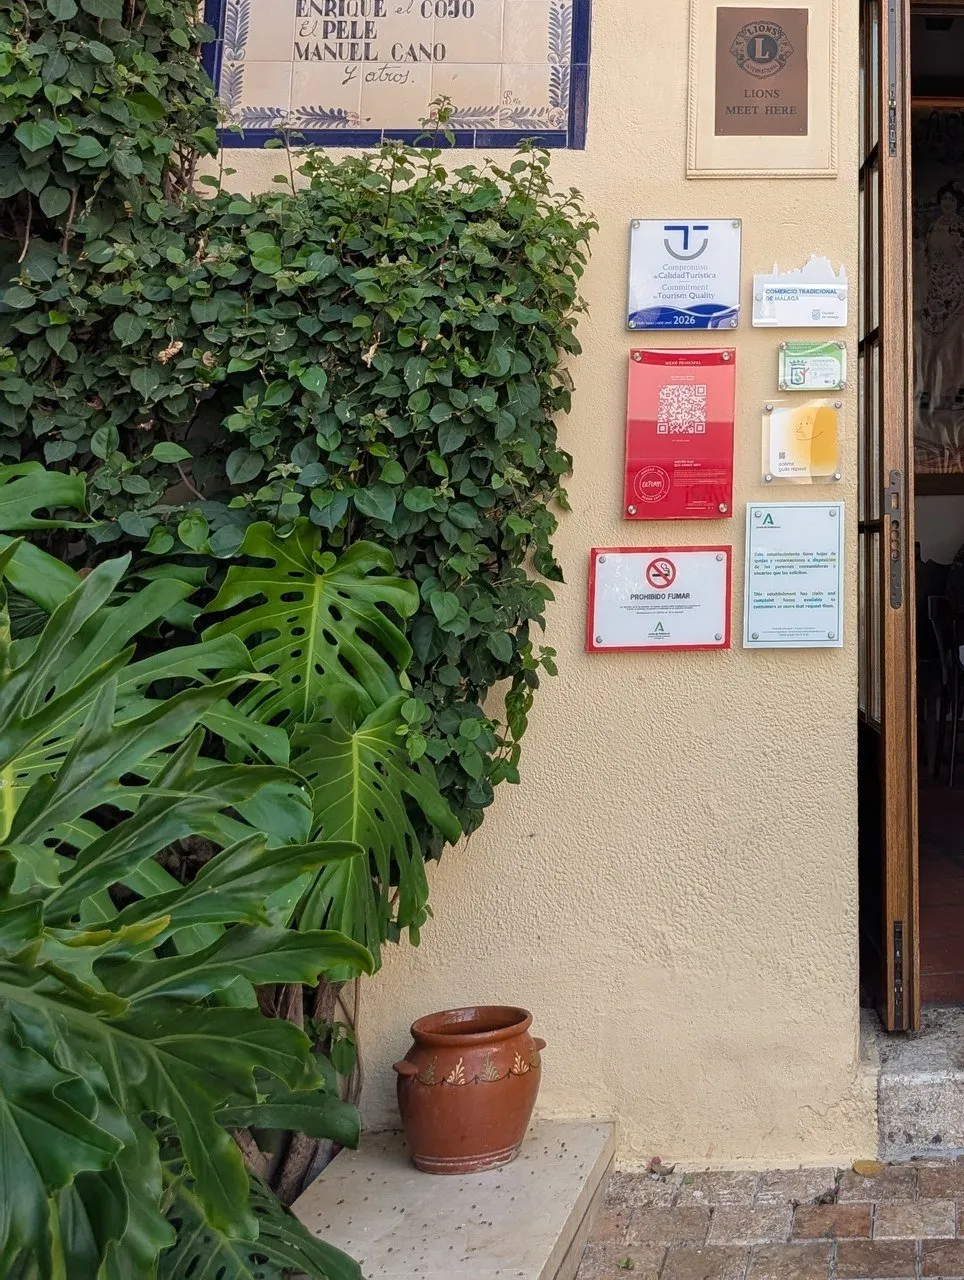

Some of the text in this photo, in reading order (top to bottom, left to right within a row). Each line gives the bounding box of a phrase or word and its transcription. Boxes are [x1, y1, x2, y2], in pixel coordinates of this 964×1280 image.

[394, 0, 414, 15] el
[420, 0, 475, 19] COJO
[299, 21, 377, 40] El PELE
[746, 24, 778, 36] LIONS
[294, 42, 447, 62] MANUEL CANO
[755, 37, 770, 59] L
[744, 89, 780, 99] LIONS
[725, 106, 797, 115] MEET HERE
[689, 292, 716, 300] Quality
[673, 316, 696, 325] 2026
